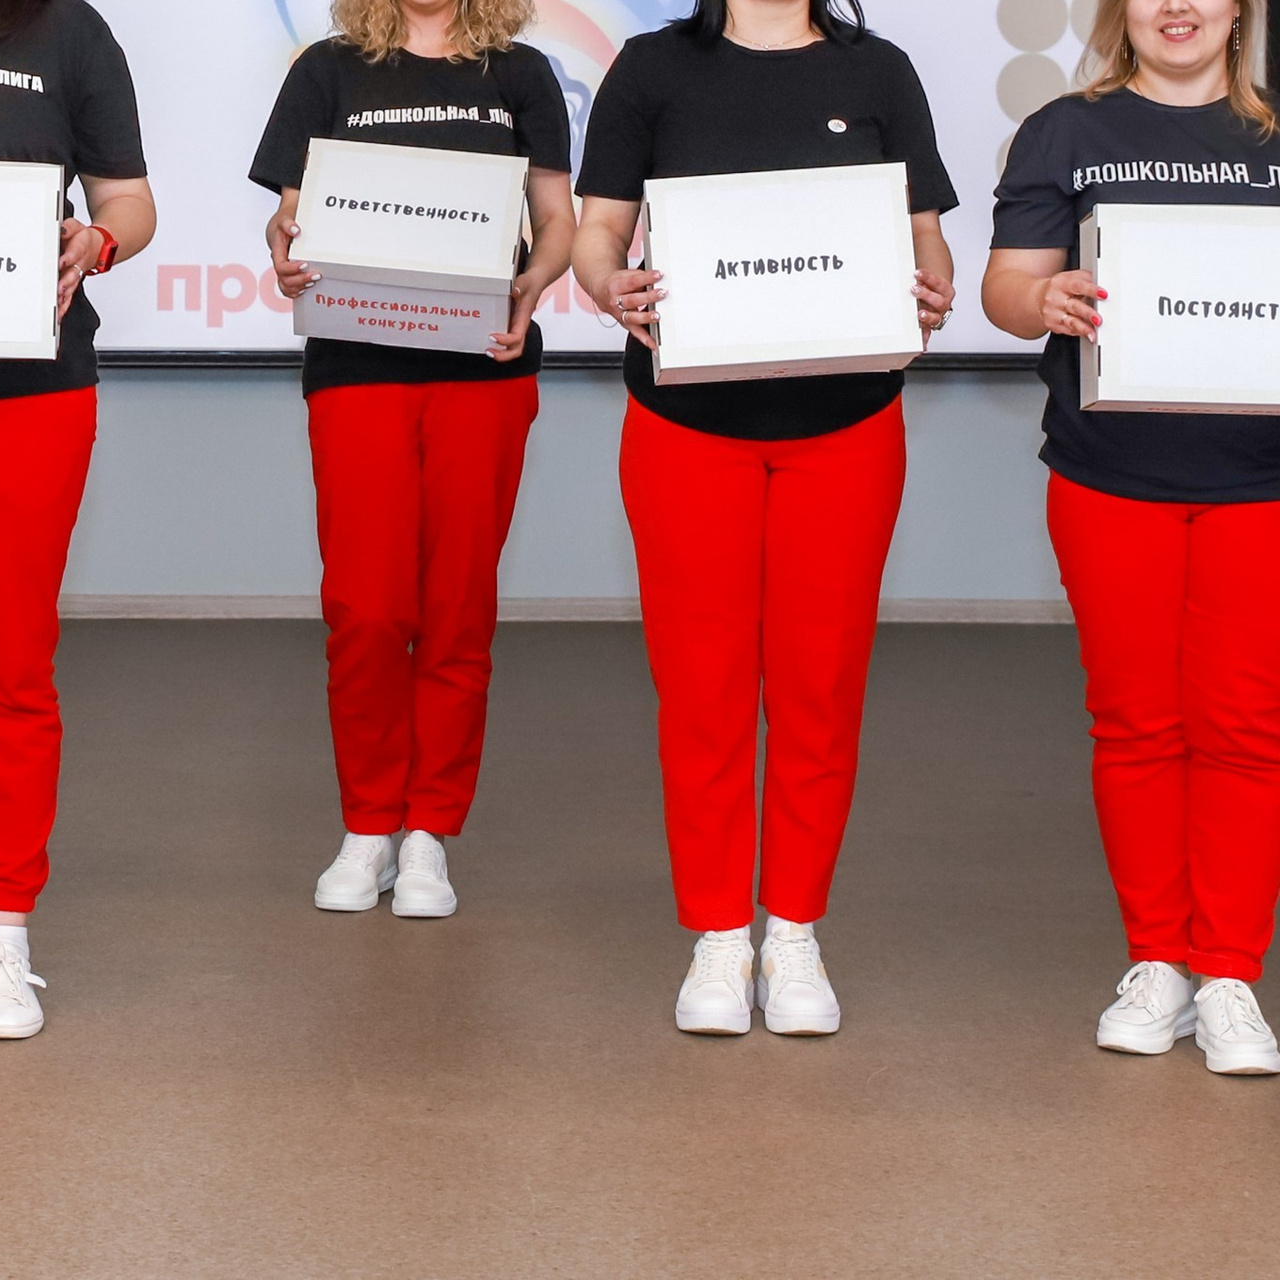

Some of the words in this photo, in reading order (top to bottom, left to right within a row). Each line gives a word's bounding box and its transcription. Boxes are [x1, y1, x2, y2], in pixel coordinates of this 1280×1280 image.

[324, 194, 492, 225] Ответственность
[714, 254, 844, 280] Активность
[315, 292, 481, 319] Профессиональные
[1158, 295, 1280, 321] Постоянст
[357, 316, 439, 333] конкурсы
